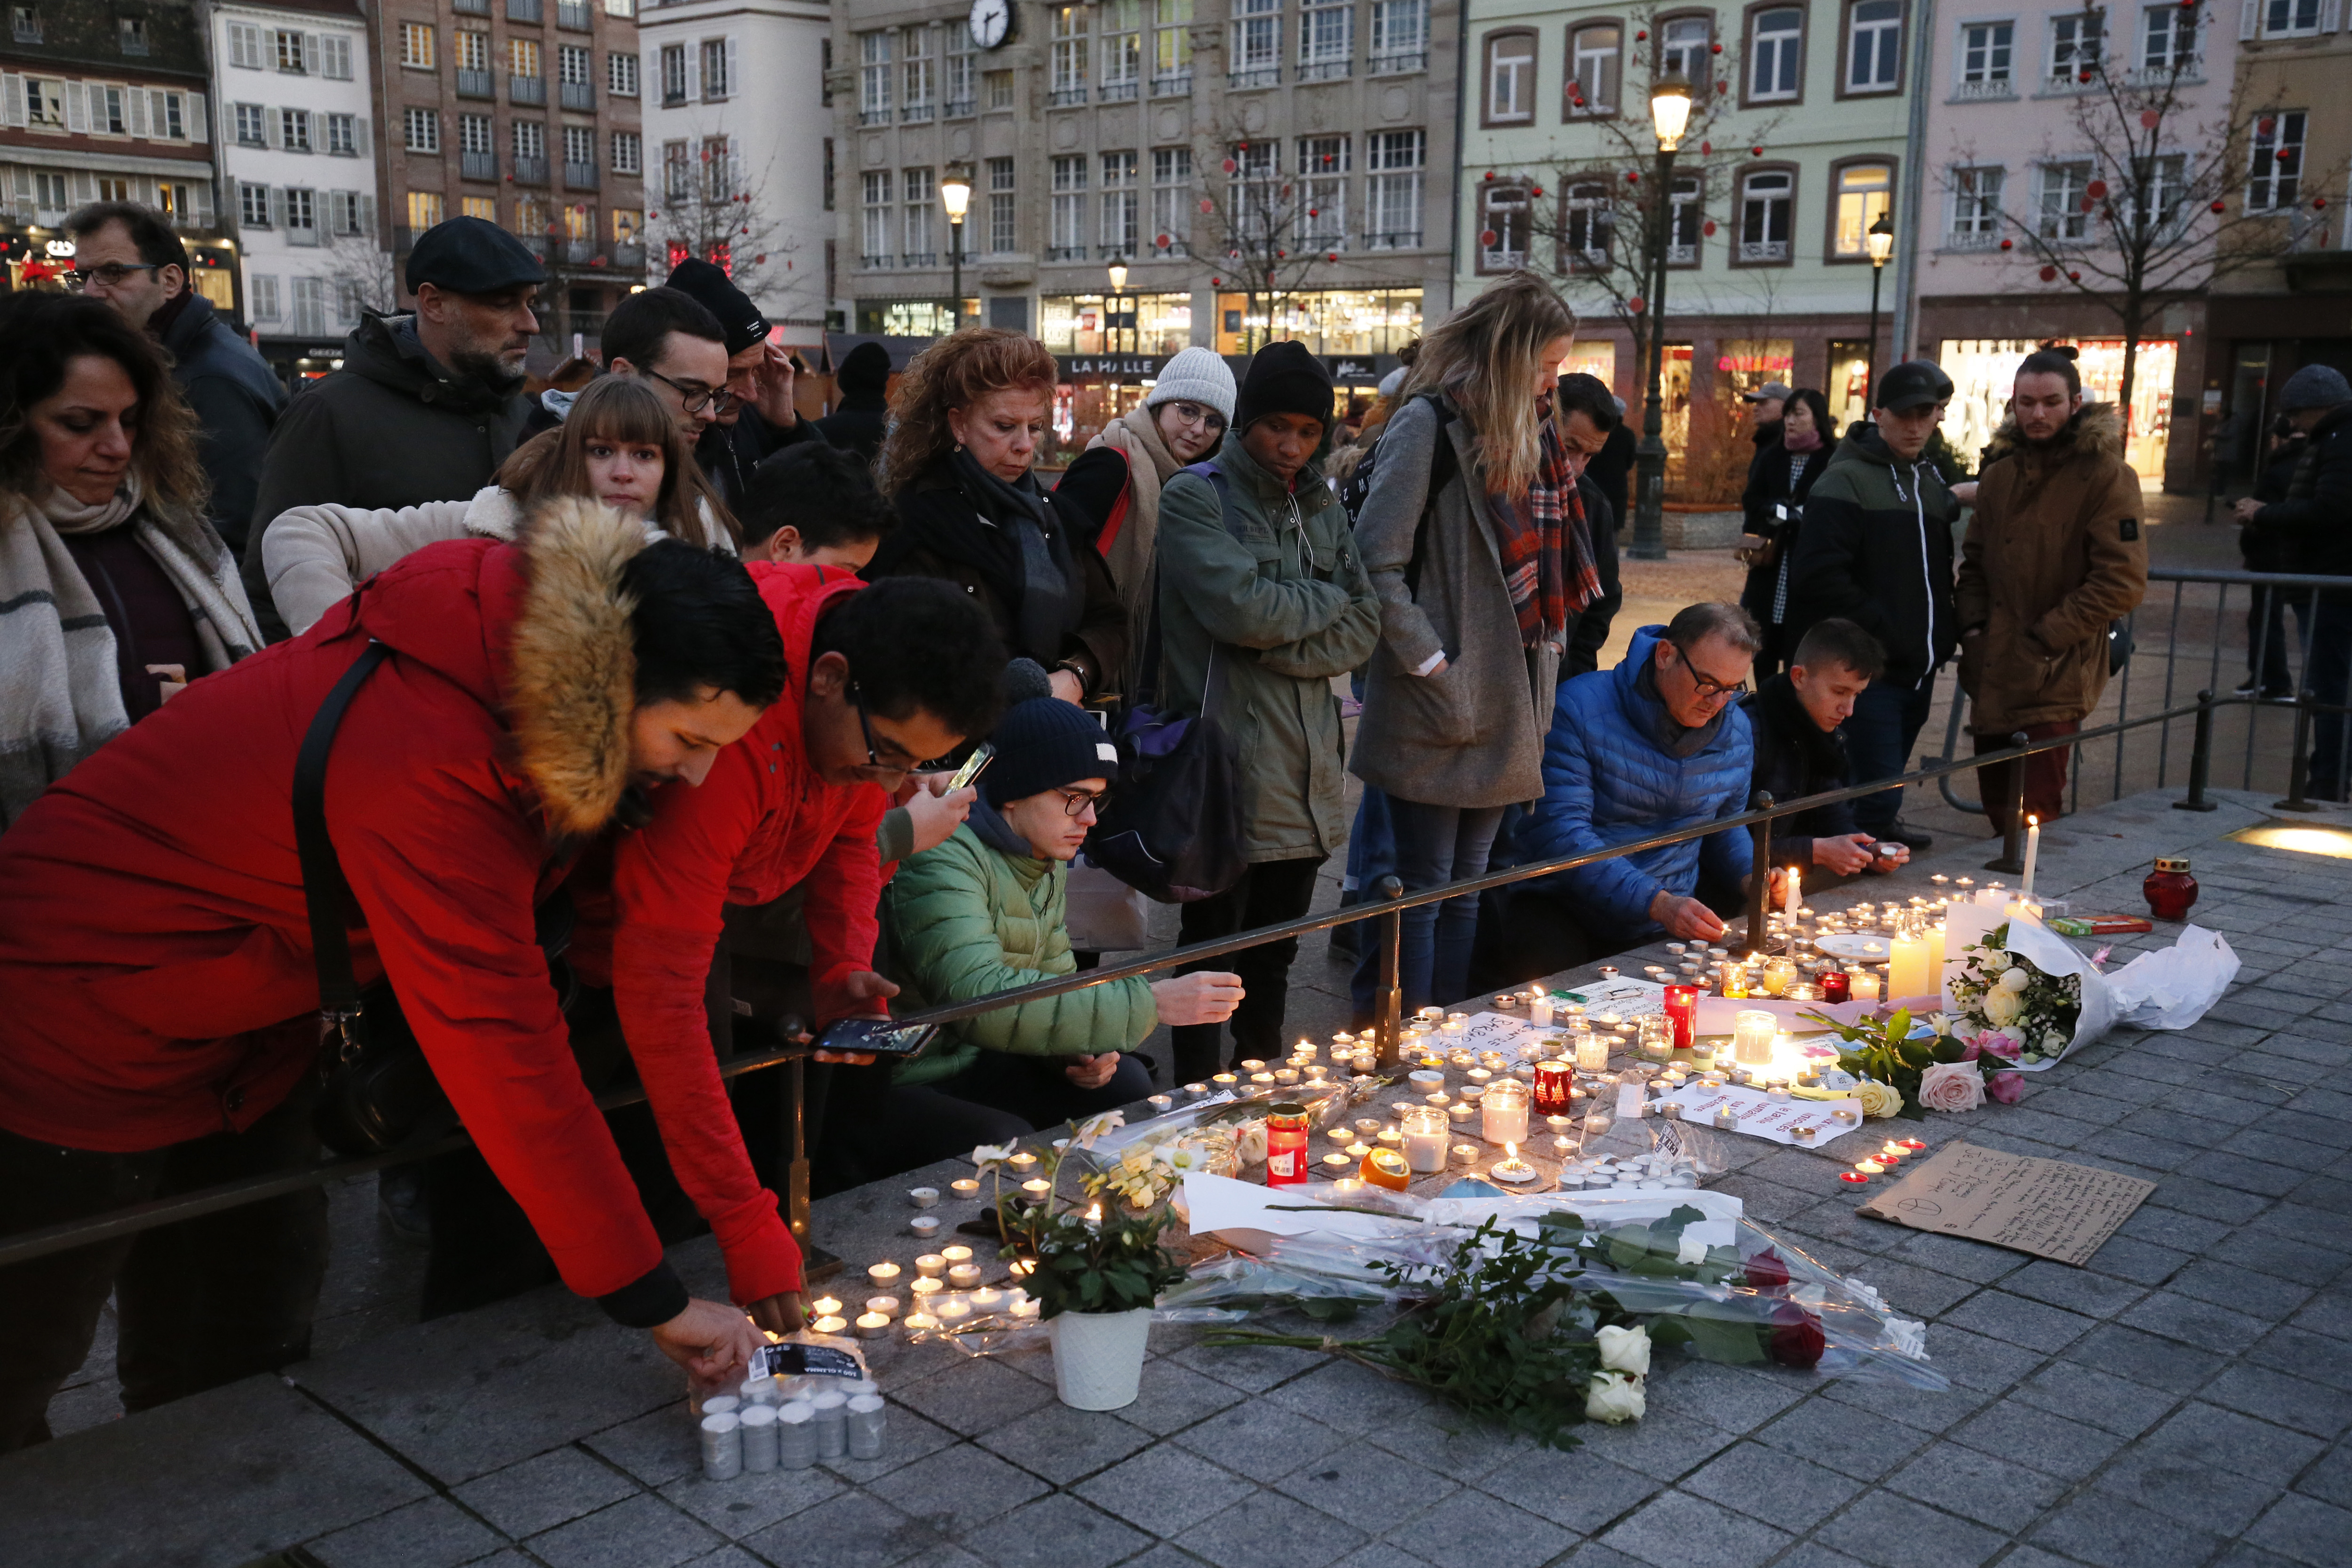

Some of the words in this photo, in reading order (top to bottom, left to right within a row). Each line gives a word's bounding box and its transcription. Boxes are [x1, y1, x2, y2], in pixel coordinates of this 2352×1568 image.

[1072, 360, 1092, 373] LA
[1439, 1018, 1513, 1053] BARBARIE
[1487, 1024, 1538, 1046] CONTRE
[1736, 1102, 1772, 1120] humaine
[1776, 1113, 1819, 1132] innocntes
